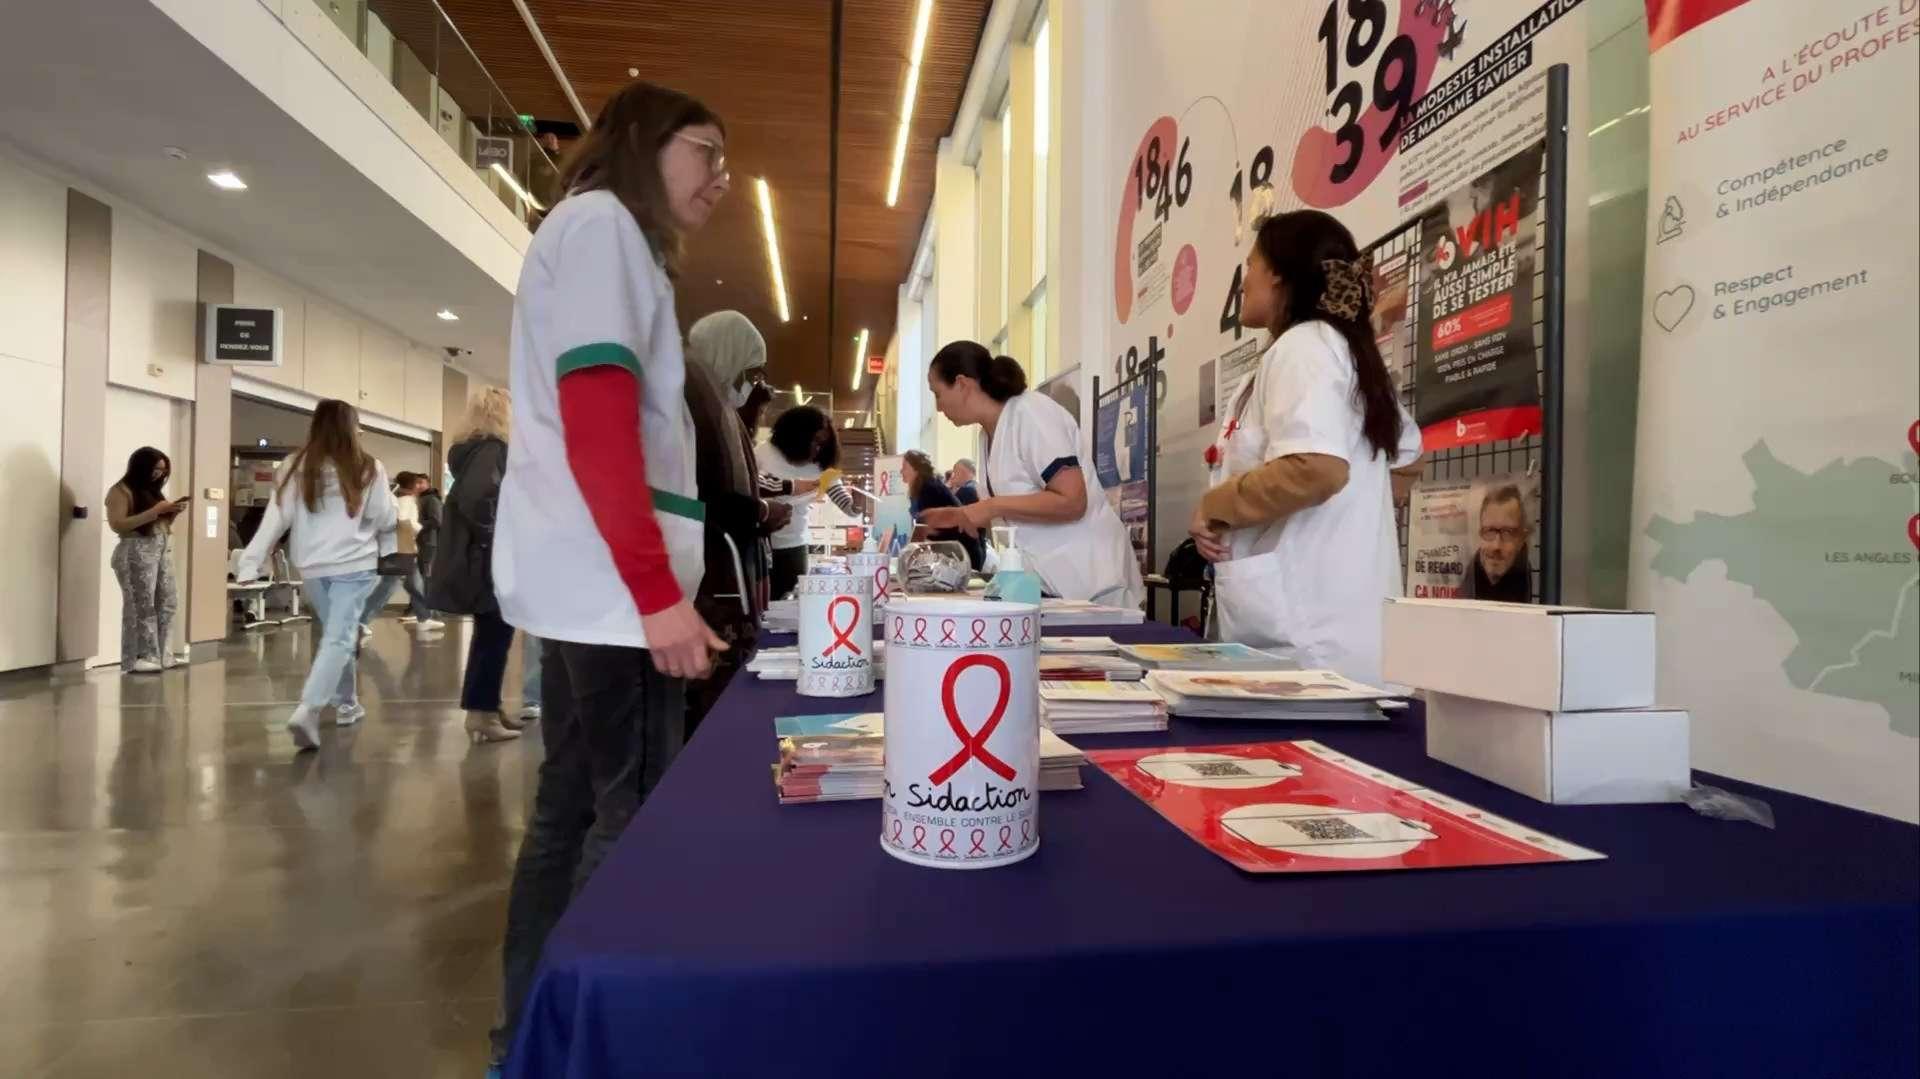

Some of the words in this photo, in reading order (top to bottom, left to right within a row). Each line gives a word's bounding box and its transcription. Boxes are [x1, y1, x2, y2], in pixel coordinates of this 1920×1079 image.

[1318, 0, 1387, 96] 18
[1762, 66, 1776, 83] A
[1782, 6, 1889, 76] L'ÉCOUTE
[1330, 34, 1417, 184] 39
[1400, 111, 1413, 128] LA
[1416, 62, 1476, 118] MODESTE
[1400, 130, 1417, 151] DE
[1418, 87, 1474, 136] MADAME
[1476, 49, 1528, 97] FAVIER
[1676, 124, 1700, 144] AU
[1705, 83, 1786, 132] SERVICE
[1793, 66, 1822, 93] DU
[1715, 202, 1730, 219] &
[1736, 147, 1889, 212] Indépendance
[1716, 138, 1848, 196] Compétence
[1455, 192, 1520, 257] VIH
[1433, 278, 1467, 304] AUSSI
[1469, 253, 1517, 288] SIMPLE
[1460, 250, 1497, 277] JAMAIS
[1714, 265, 1794, 297] Respect
[1433, 301, 1448, 319] DE
[1451, 294, 1465, 312] SE
[1468, 272, 1514, 304] TESTER
[1712, 303, 1726, 320] &
[1733, 269, 1869, 316] Engagement
[1414, 560, 1426, 574] DE
[1428, 561, 1464, 575] REGARD
[1825, 552, 1849, 563] LES
[1853, 552, 1912, 564] ANGLES
[904, 812, 957, 827] ENSEMBLE
[961, 815, 1002, 827] CONTRE
[907, 782, 1031, 812] Sidaction
